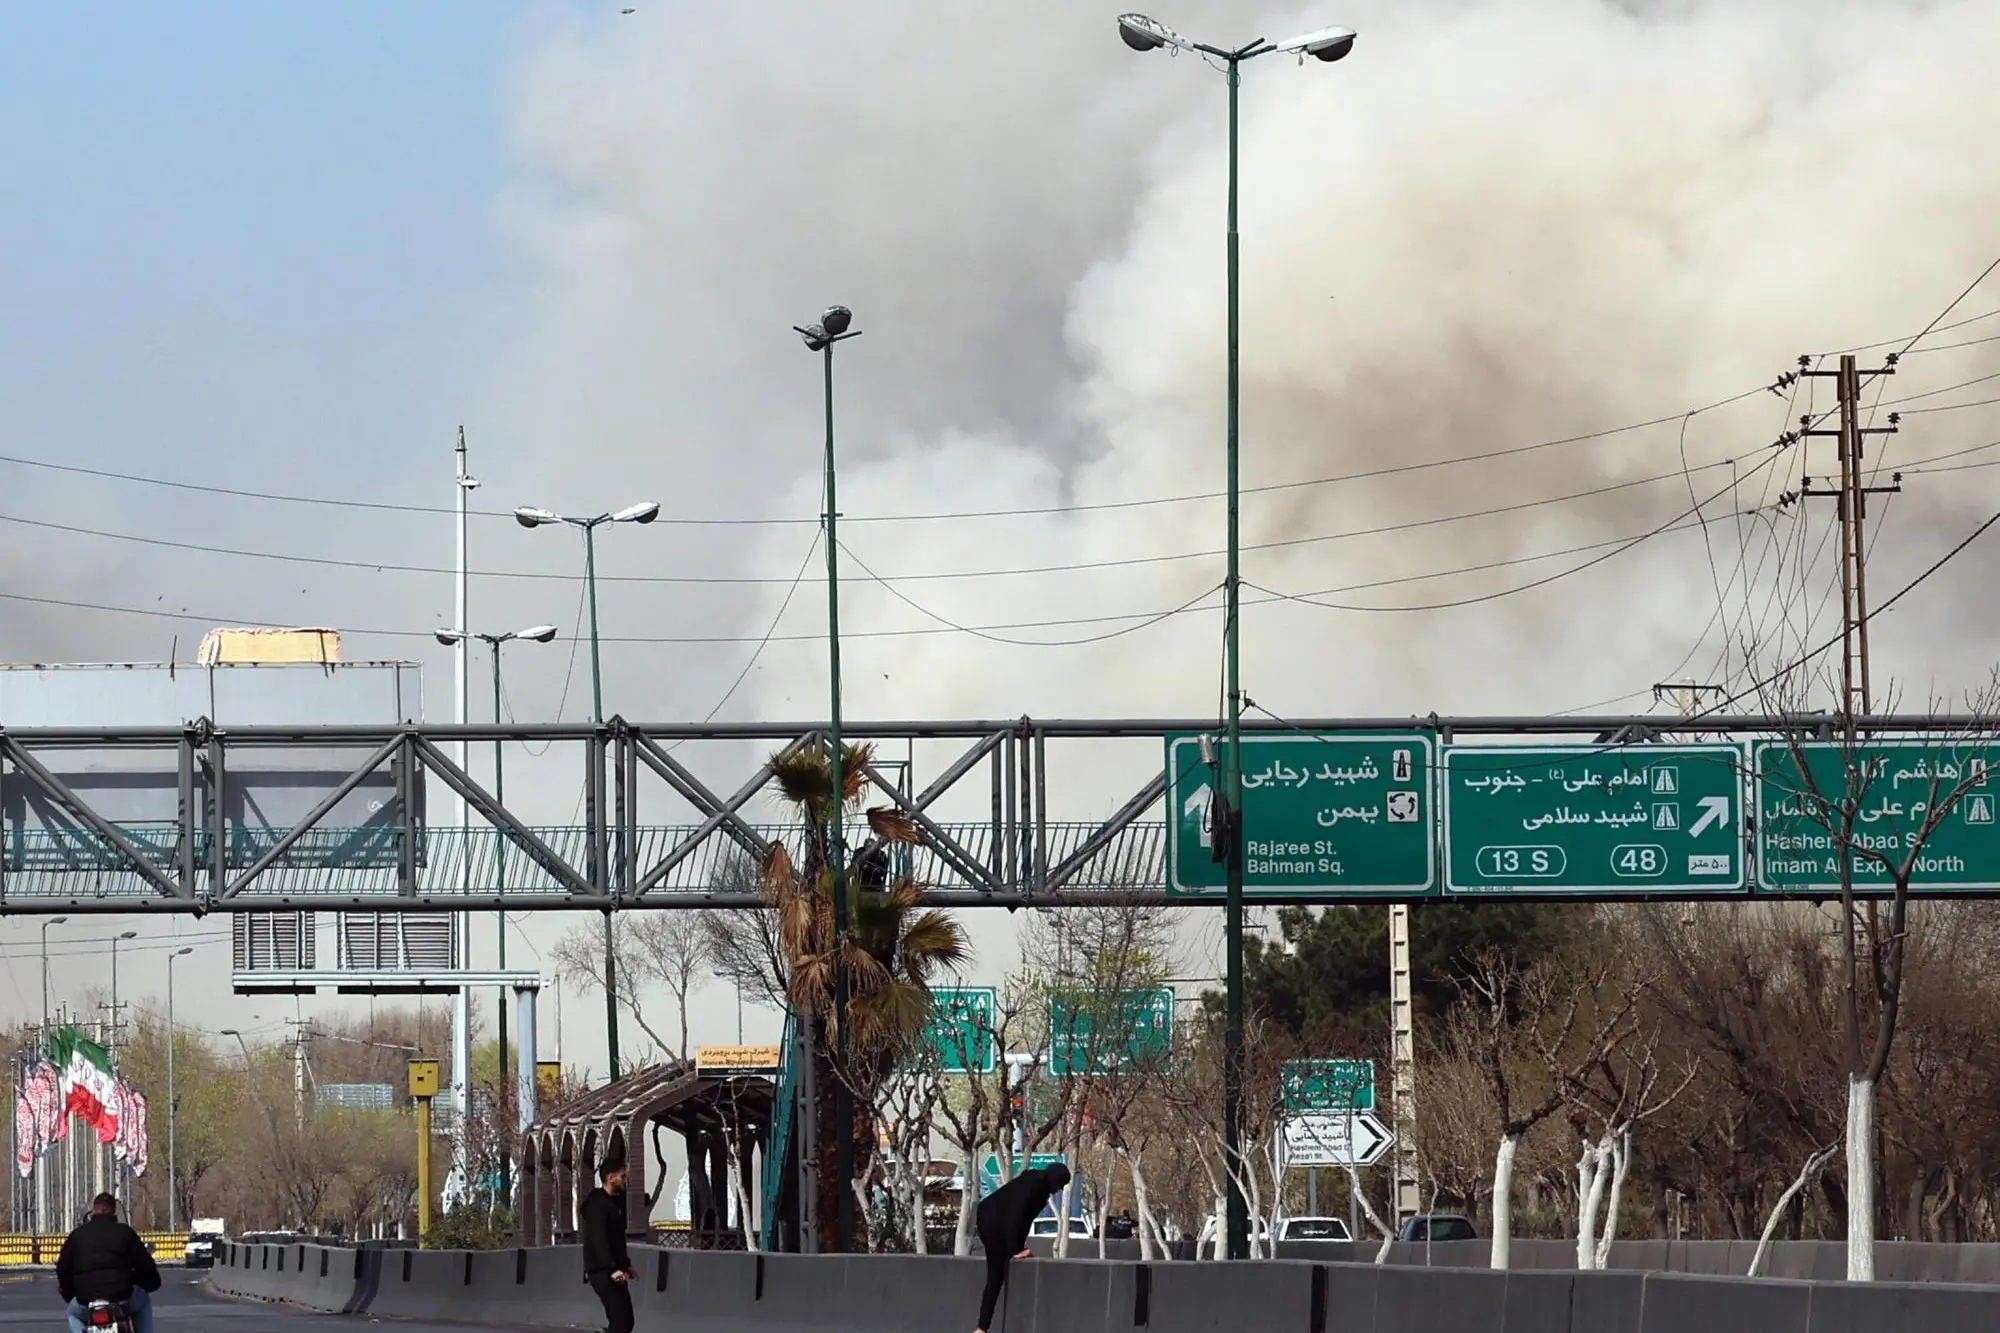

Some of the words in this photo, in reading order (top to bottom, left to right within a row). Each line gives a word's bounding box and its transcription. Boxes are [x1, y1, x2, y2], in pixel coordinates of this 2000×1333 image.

[1241, 760, 1310, 788] رجایی
[1316, 756, 1379, 786] شهید
[1465, 770, 1526, 795] جنوب
[1563, 769, 1602, 793] علی
[1608, 769, 1648, 796] امام
[1317, 805, 1379, 827] بهمن
[1523, 807, 1590, 831] سلامی
[1595, 802, 1648, 828] شهید
[1860, 796, 1904, 823] علی
[1248, 841, 1310, 857] Raja'ee
[1314, 840, 1337, 855] St.
[1850, 832, 1899, 849] Abad
[1248, 859, 1315, 874] Bahman
[1318, 859, 1345, 876] Sq.
[1492, 850, 1519, 872] 13
[1532, 850, 1550, 872] S
[1620, 849, 1657, 871] 48
[1689, 859, 1708, 871] متر
[1767, 858, 1818, 873] Imam
[1912, 855, 1965, 873] North
